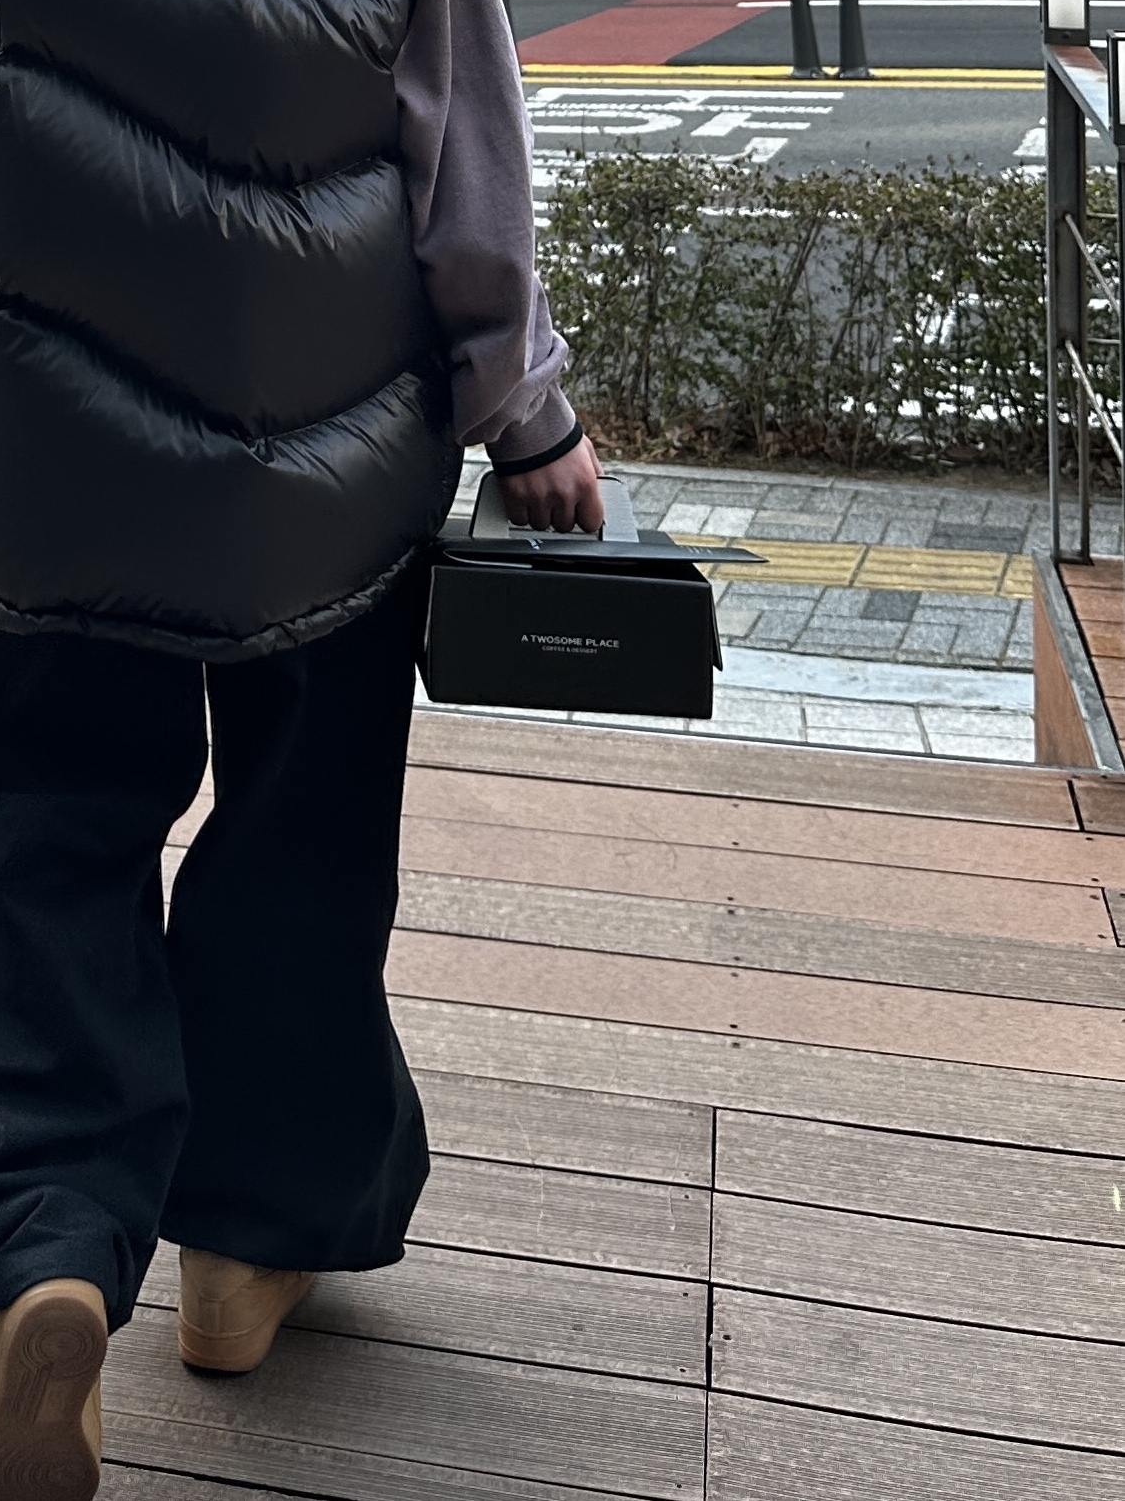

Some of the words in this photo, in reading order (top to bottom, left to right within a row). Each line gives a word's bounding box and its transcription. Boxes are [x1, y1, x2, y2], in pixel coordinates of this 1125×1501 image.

[521, 634, 529, 642] A
[530, 634, 583, 646] TWOSOME
[585, 638, 620, 649] PLACE
